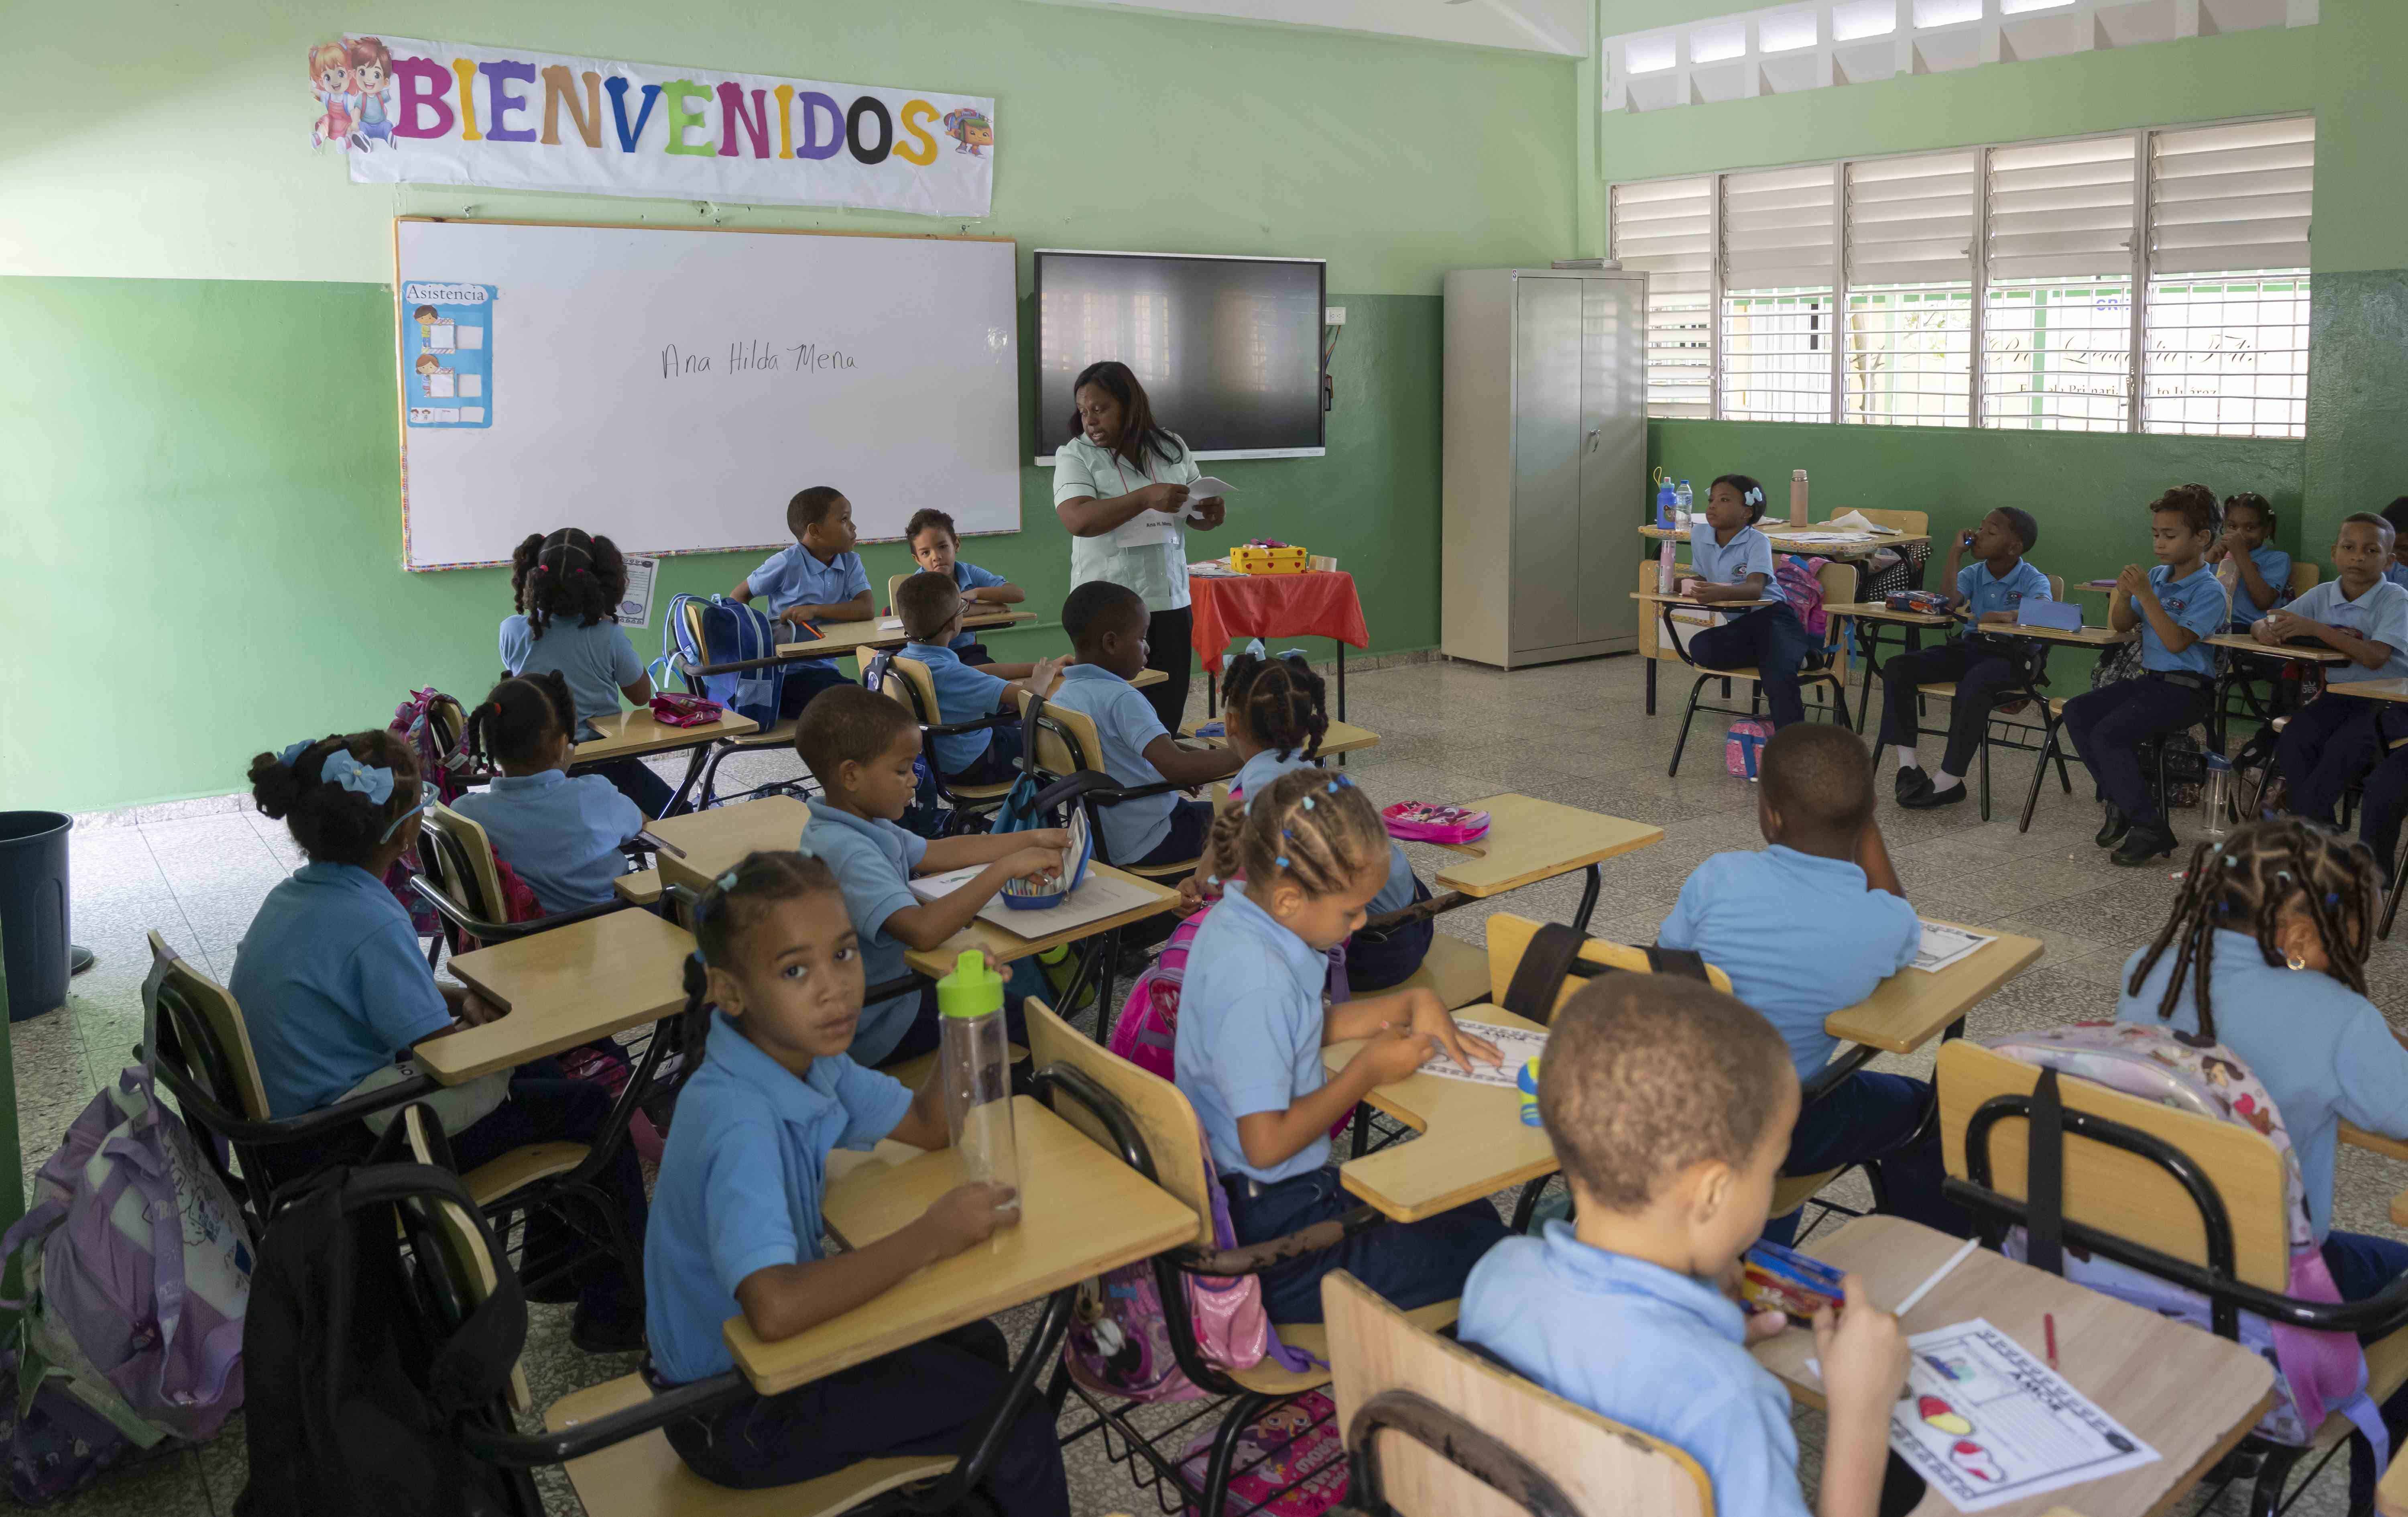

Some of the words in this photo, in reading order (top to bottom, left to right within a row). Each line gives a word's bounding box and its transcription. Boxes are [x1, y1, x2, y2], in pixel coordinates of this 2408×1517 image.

[392, 57, 940, 165] BIENVENIDOS
[407, 285, 484, 300] Asistencia
[662, 344, 711, 379] Ana
[730, 339, 779, 375] Hilda
[786, 343, 859, 374] Mena
